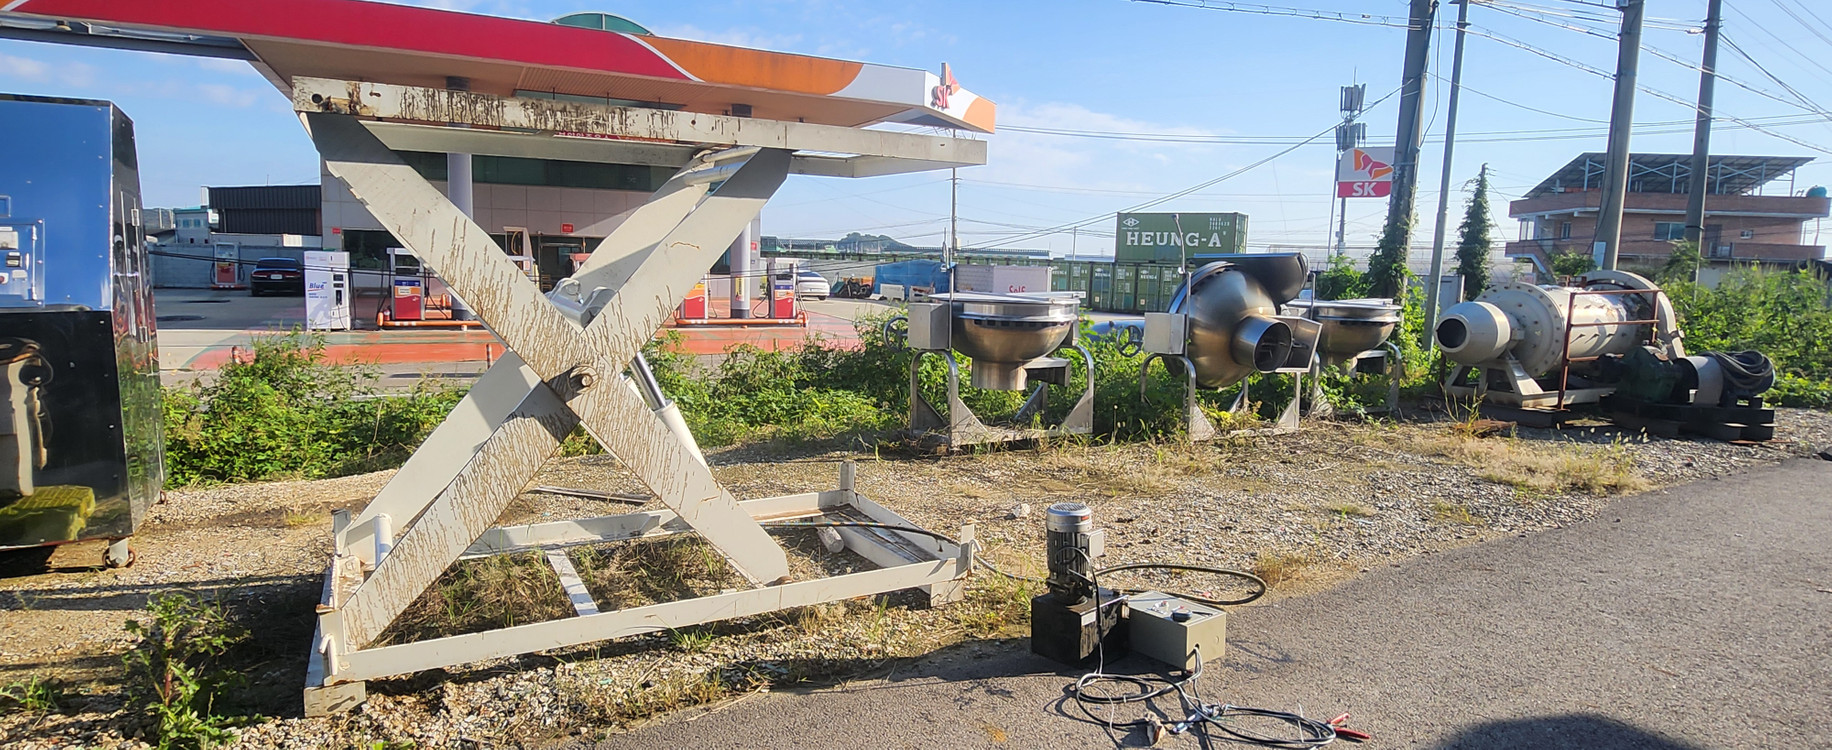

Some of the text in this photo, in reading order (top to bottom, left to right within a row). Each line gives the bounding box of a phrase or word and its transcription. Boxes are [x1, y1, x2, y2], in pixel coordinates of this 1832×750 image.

[933, 85, 951, 109] SK
[1352, 182, 1377, 196] SK
[1126, 231, 1222, 247] HEUNG-A
